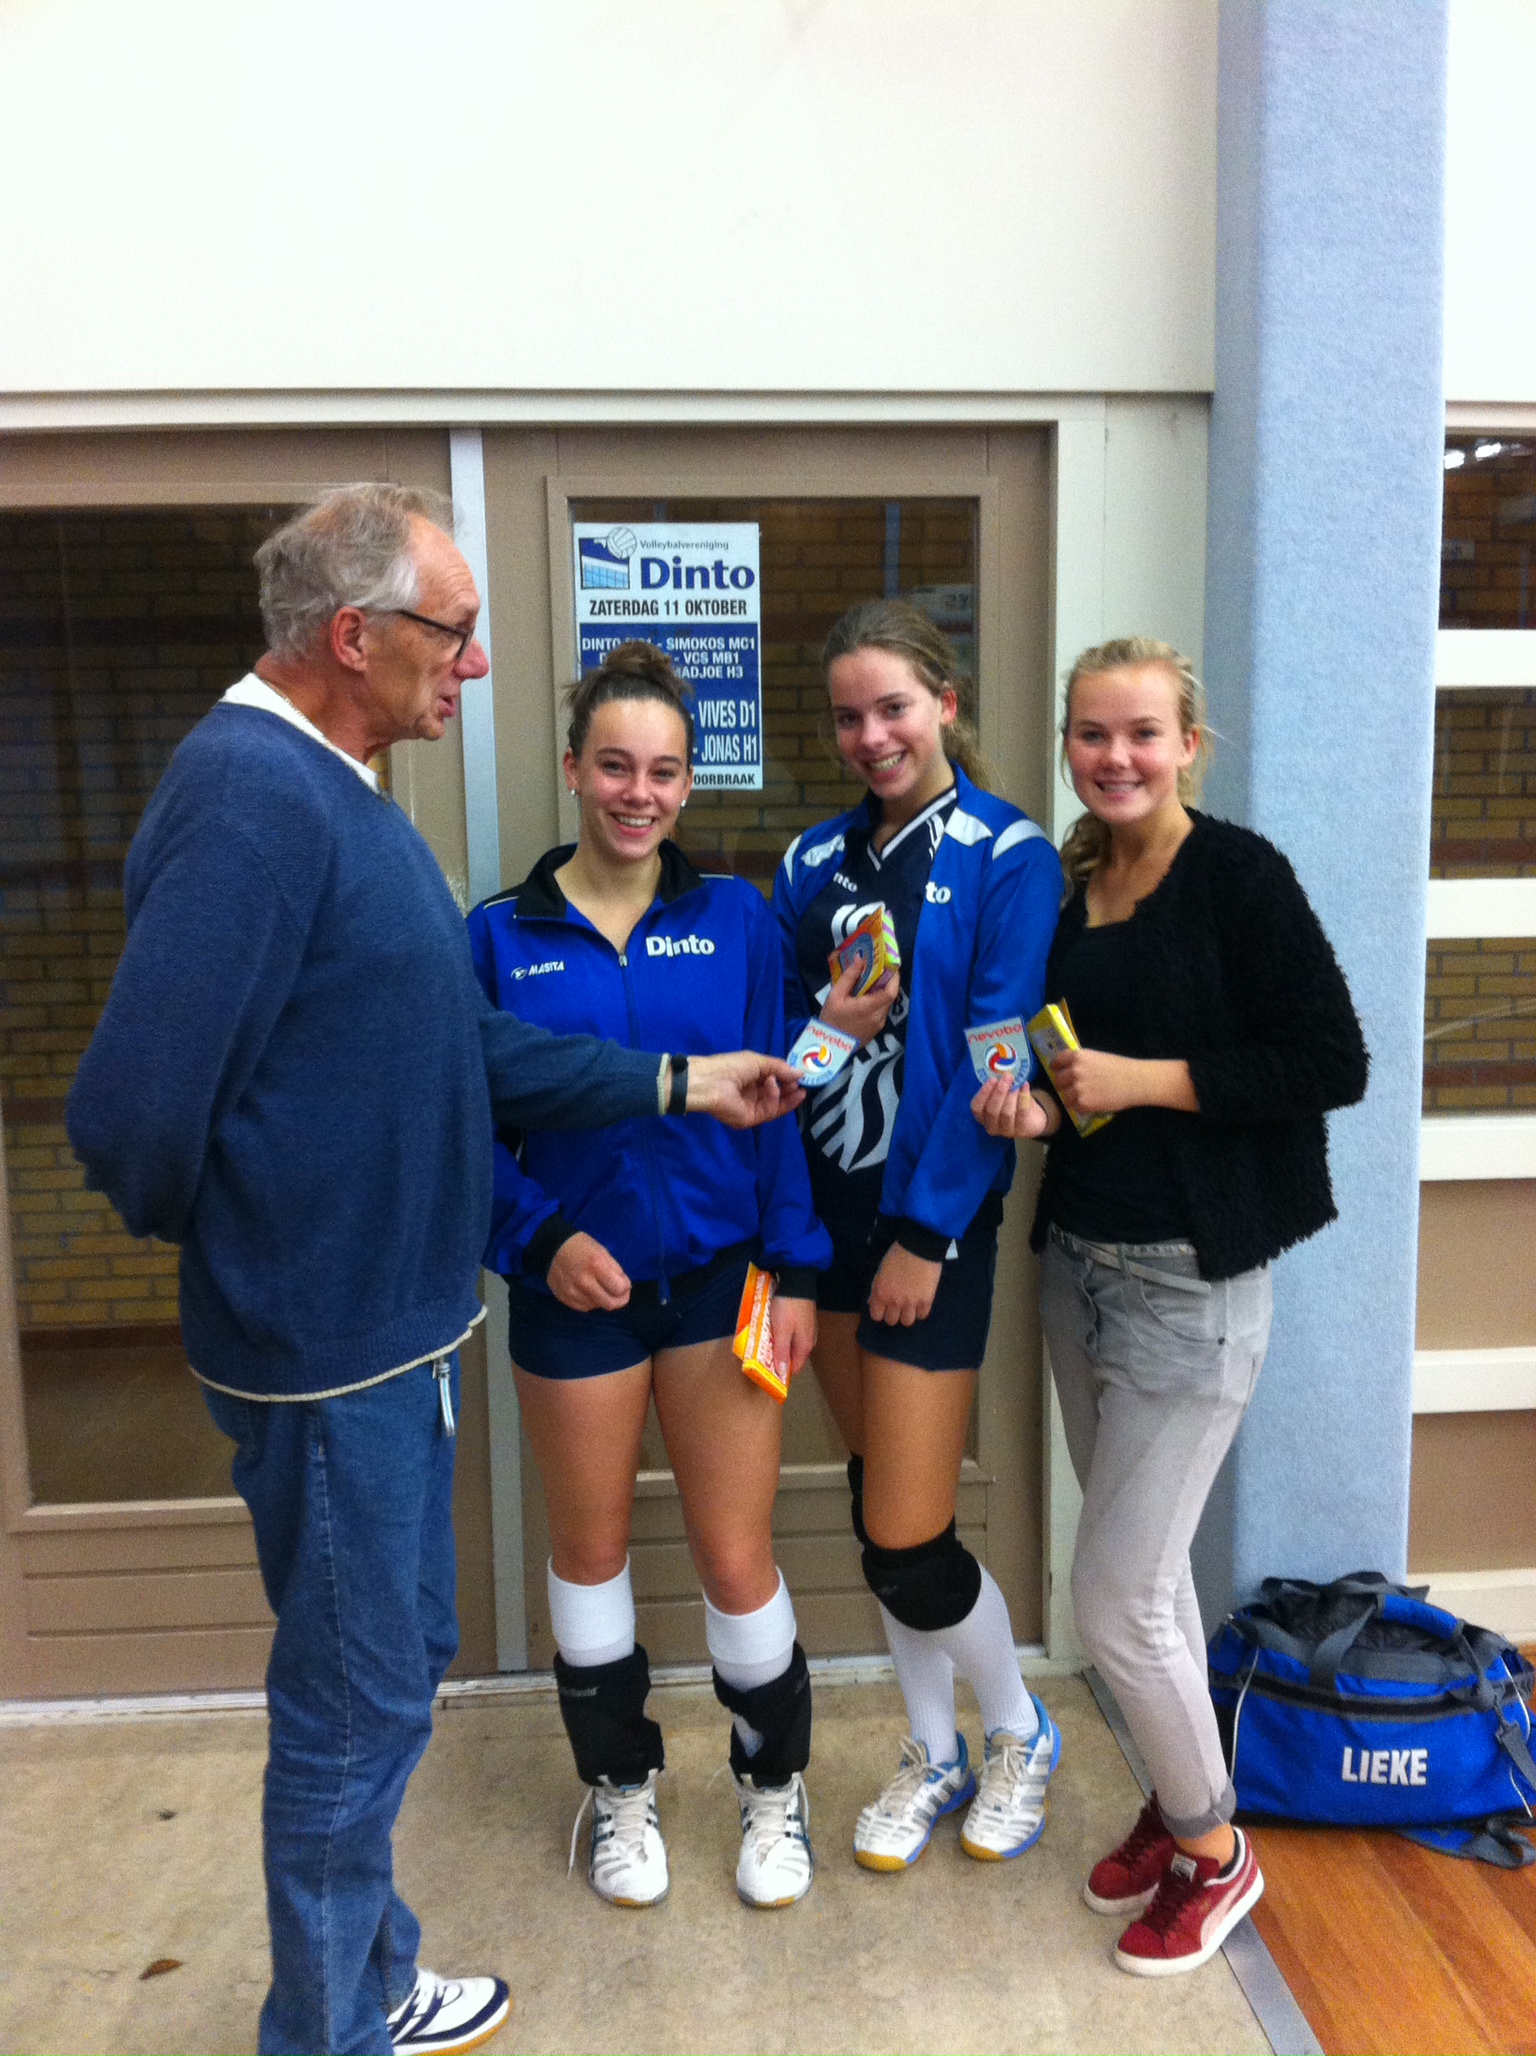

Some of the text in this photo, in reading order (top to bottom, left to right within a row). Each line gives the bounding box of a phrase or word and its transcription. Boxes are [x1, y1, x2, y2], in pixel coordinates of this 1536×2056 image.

[640, 540, 729, 550] Volleybalvereniging
[640, 556, 755, 589] Dinto
[590, 600, 747, 615] ZATERDAG 11 OKTOBER
[666, 637, 725, 651] SIMOKOS
[729, 637, 755, 651] MC1
[683, 652, 709, 665] VCS
[712, 652, 739, 665] MB1
[727, 665, 743, 679] H3
[698, 700, 736, 728] VIVES
[740, 700, 755, 728] D1
[701, 734, 740, 763] JONAS
[743, 734, 757, 762] H1
[693, 773, 755, 785] OORBRAAK
[645, 934, 715, 958] Dinto
[528, 961, 565, 976] MASITA
[1341, 1746, 1428, 1786] LIEKE
